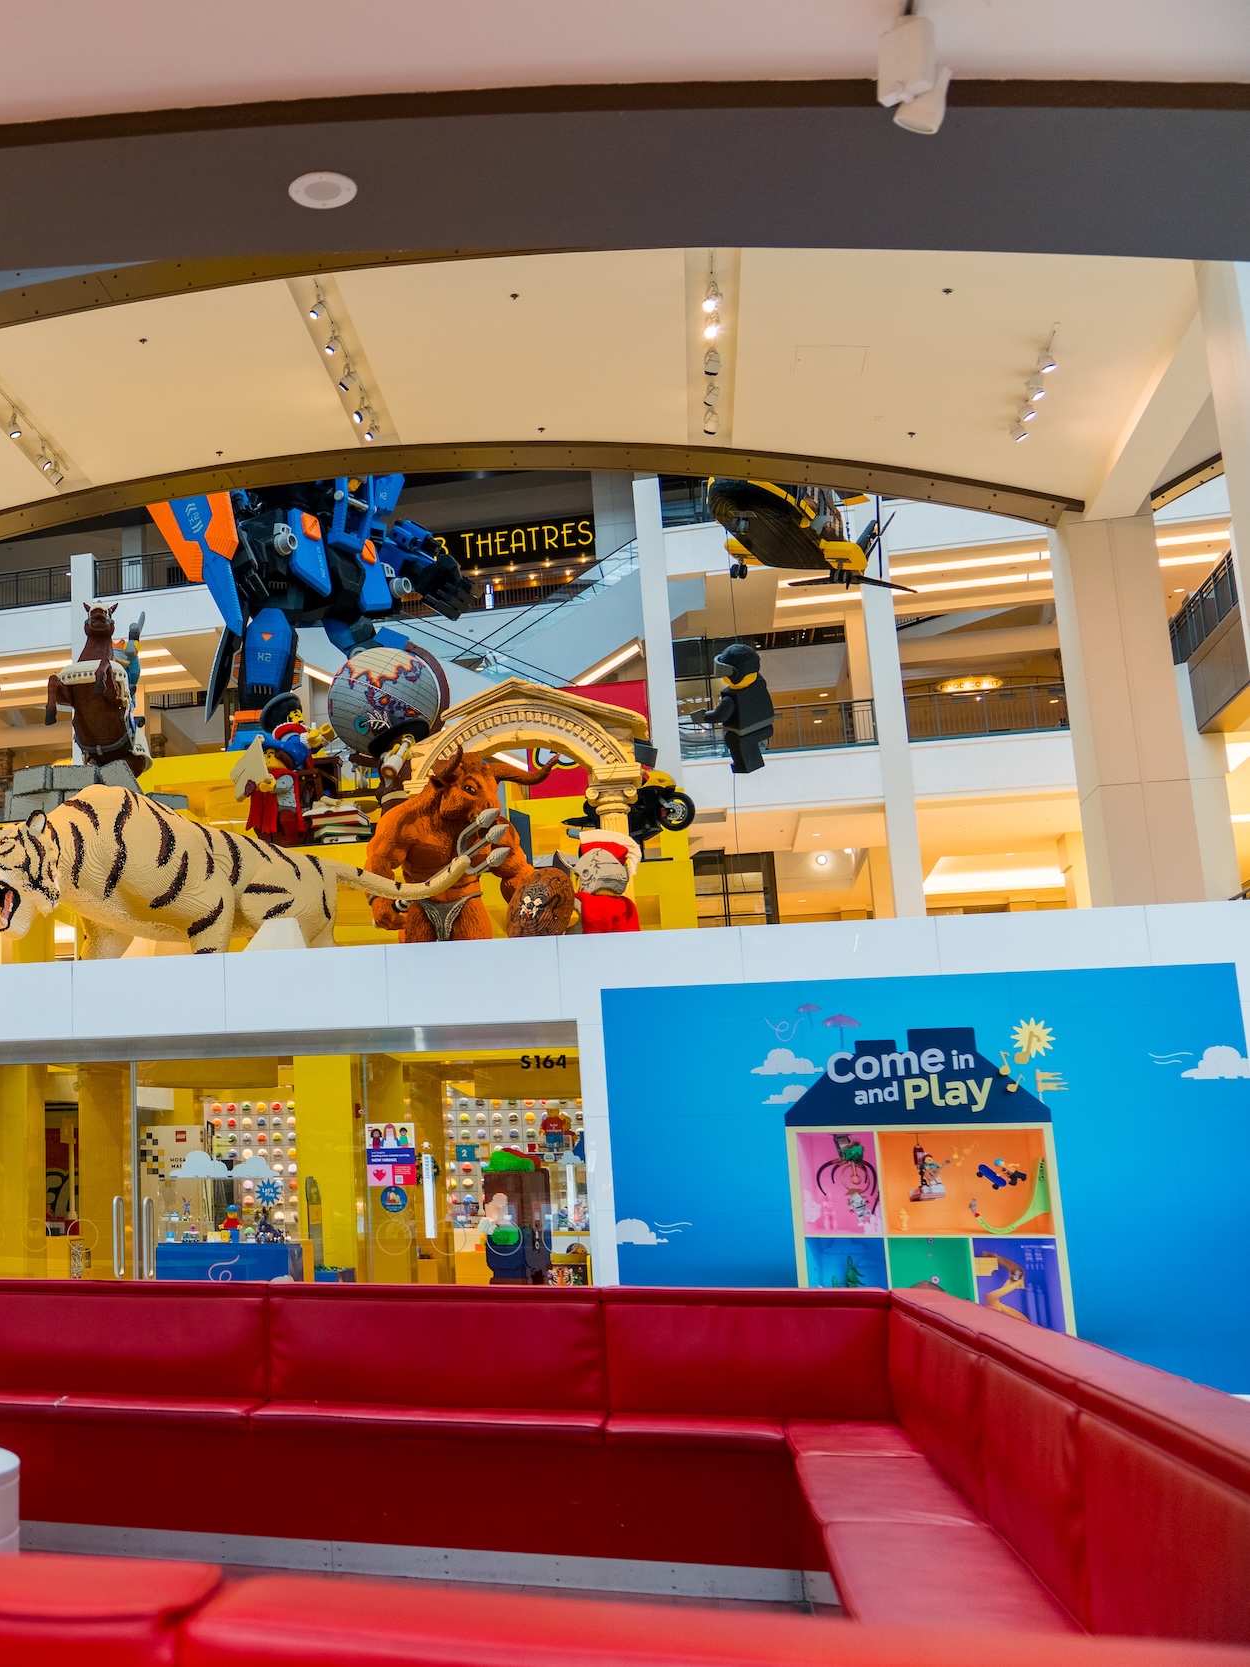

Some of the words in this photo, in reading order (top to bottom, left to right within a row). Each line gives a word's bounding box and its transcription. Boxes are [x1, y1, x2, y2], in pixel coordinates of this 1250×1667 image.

[460, 520, 594, 559] THEATRES
[940, 682, 965, 690] FOOD
[969, 680, 1000, 688] COURT
[520, 1055, 566, 1069] S164
[827, 1048, 945, 1083] Come
[951, 1050, 975, 1070] in
[854, 1081, 899, 1105] and
[903, 1074, 993, 1112] Play
